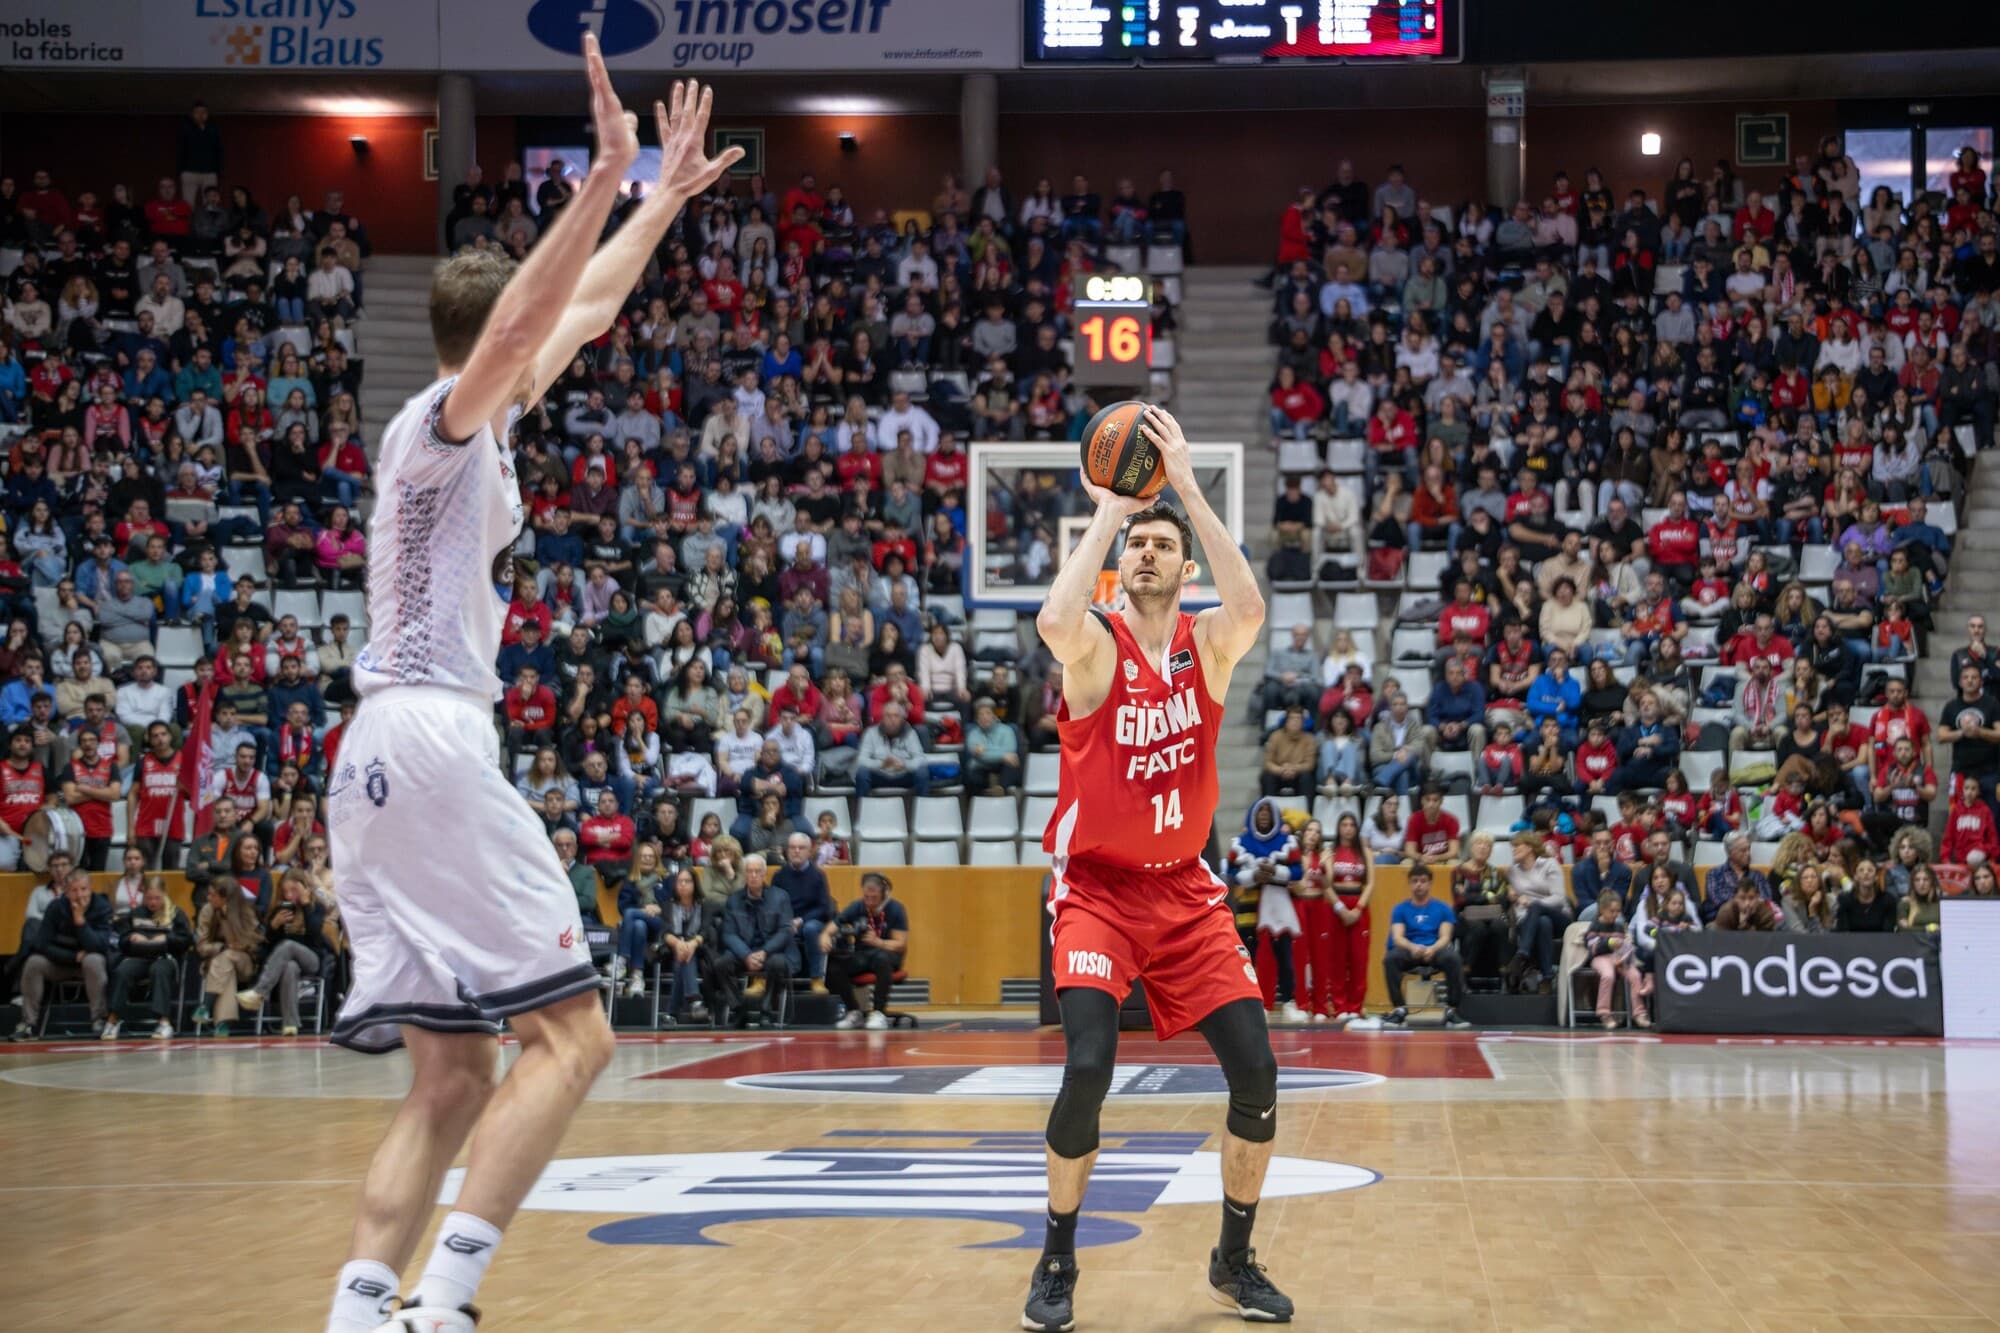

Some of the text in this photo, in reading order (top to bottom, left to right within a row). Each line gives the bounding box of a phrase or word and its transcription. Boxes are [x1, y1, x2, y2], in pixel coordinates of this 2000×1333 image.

[674, 0, 891, 34] infoself
[13, 42, 123, 61] la fàbrica
[269, 26, 384, 66] Blaus
[673, 41, 753, 67] group
[883, 48, 984, 59] www.infoself.com
[1080, 315, 1141, 362] 16
[1127, 737, 1195, 780] FATC
[1151, 788, 1184, 834] 14
[1068, 950, 1112, 981] YOSOY
[1665, 943, 1928, 998] endesa
